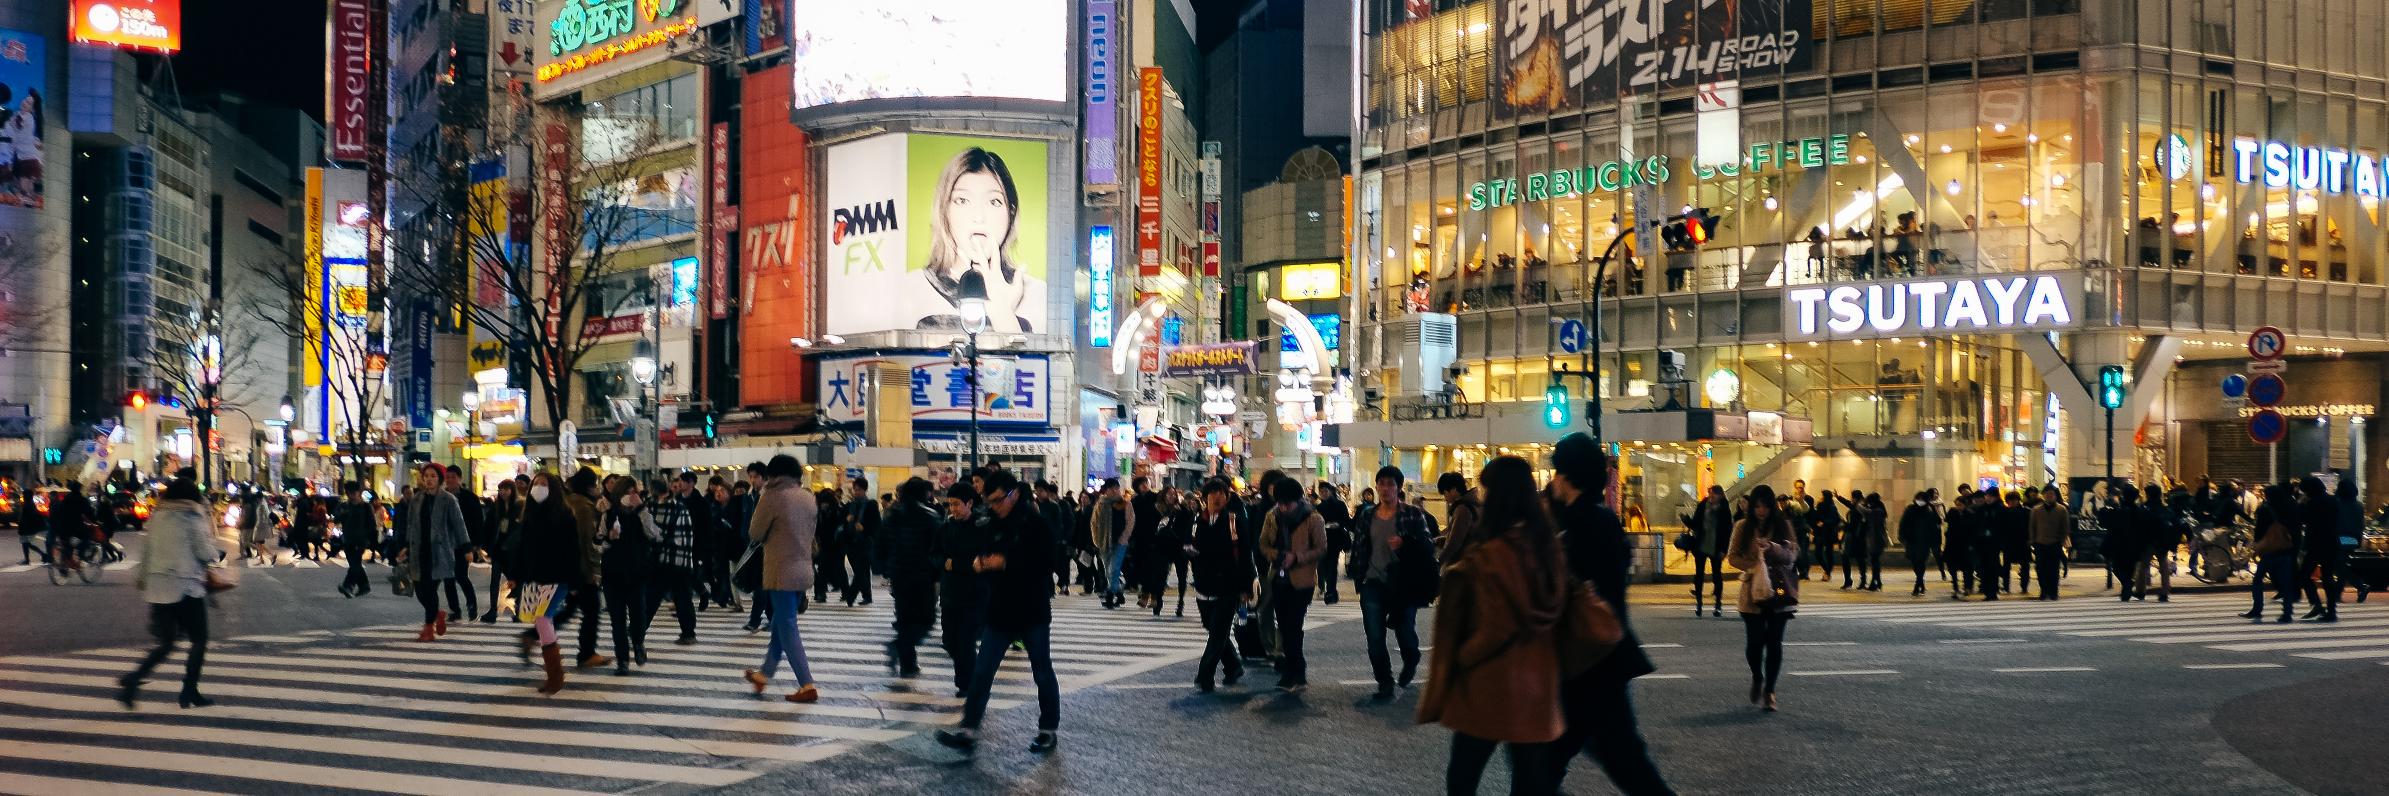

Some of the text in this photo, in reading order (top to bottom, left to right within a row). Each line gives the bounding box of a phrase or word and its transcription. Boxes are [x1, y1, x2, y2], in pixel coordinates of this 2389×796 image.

[1716, 47, 1798, 73] SHOW
[1721, 30, 1800, 55] ROAD
[336, 1, 365, 152] Essential
[1629, 41, 1721, 87] 2.14
[1470, 154, 1671, 211] STARBUCKS
[2233, 139, 2389, 199] TSUTA
[833, 199, 898, 237] DMM
[843, 239, 886, 278] FX
[1791, 276, 2071, 334] TSUTAYA
[2238, 403, 2375, 417] STUCKS COFFEE
